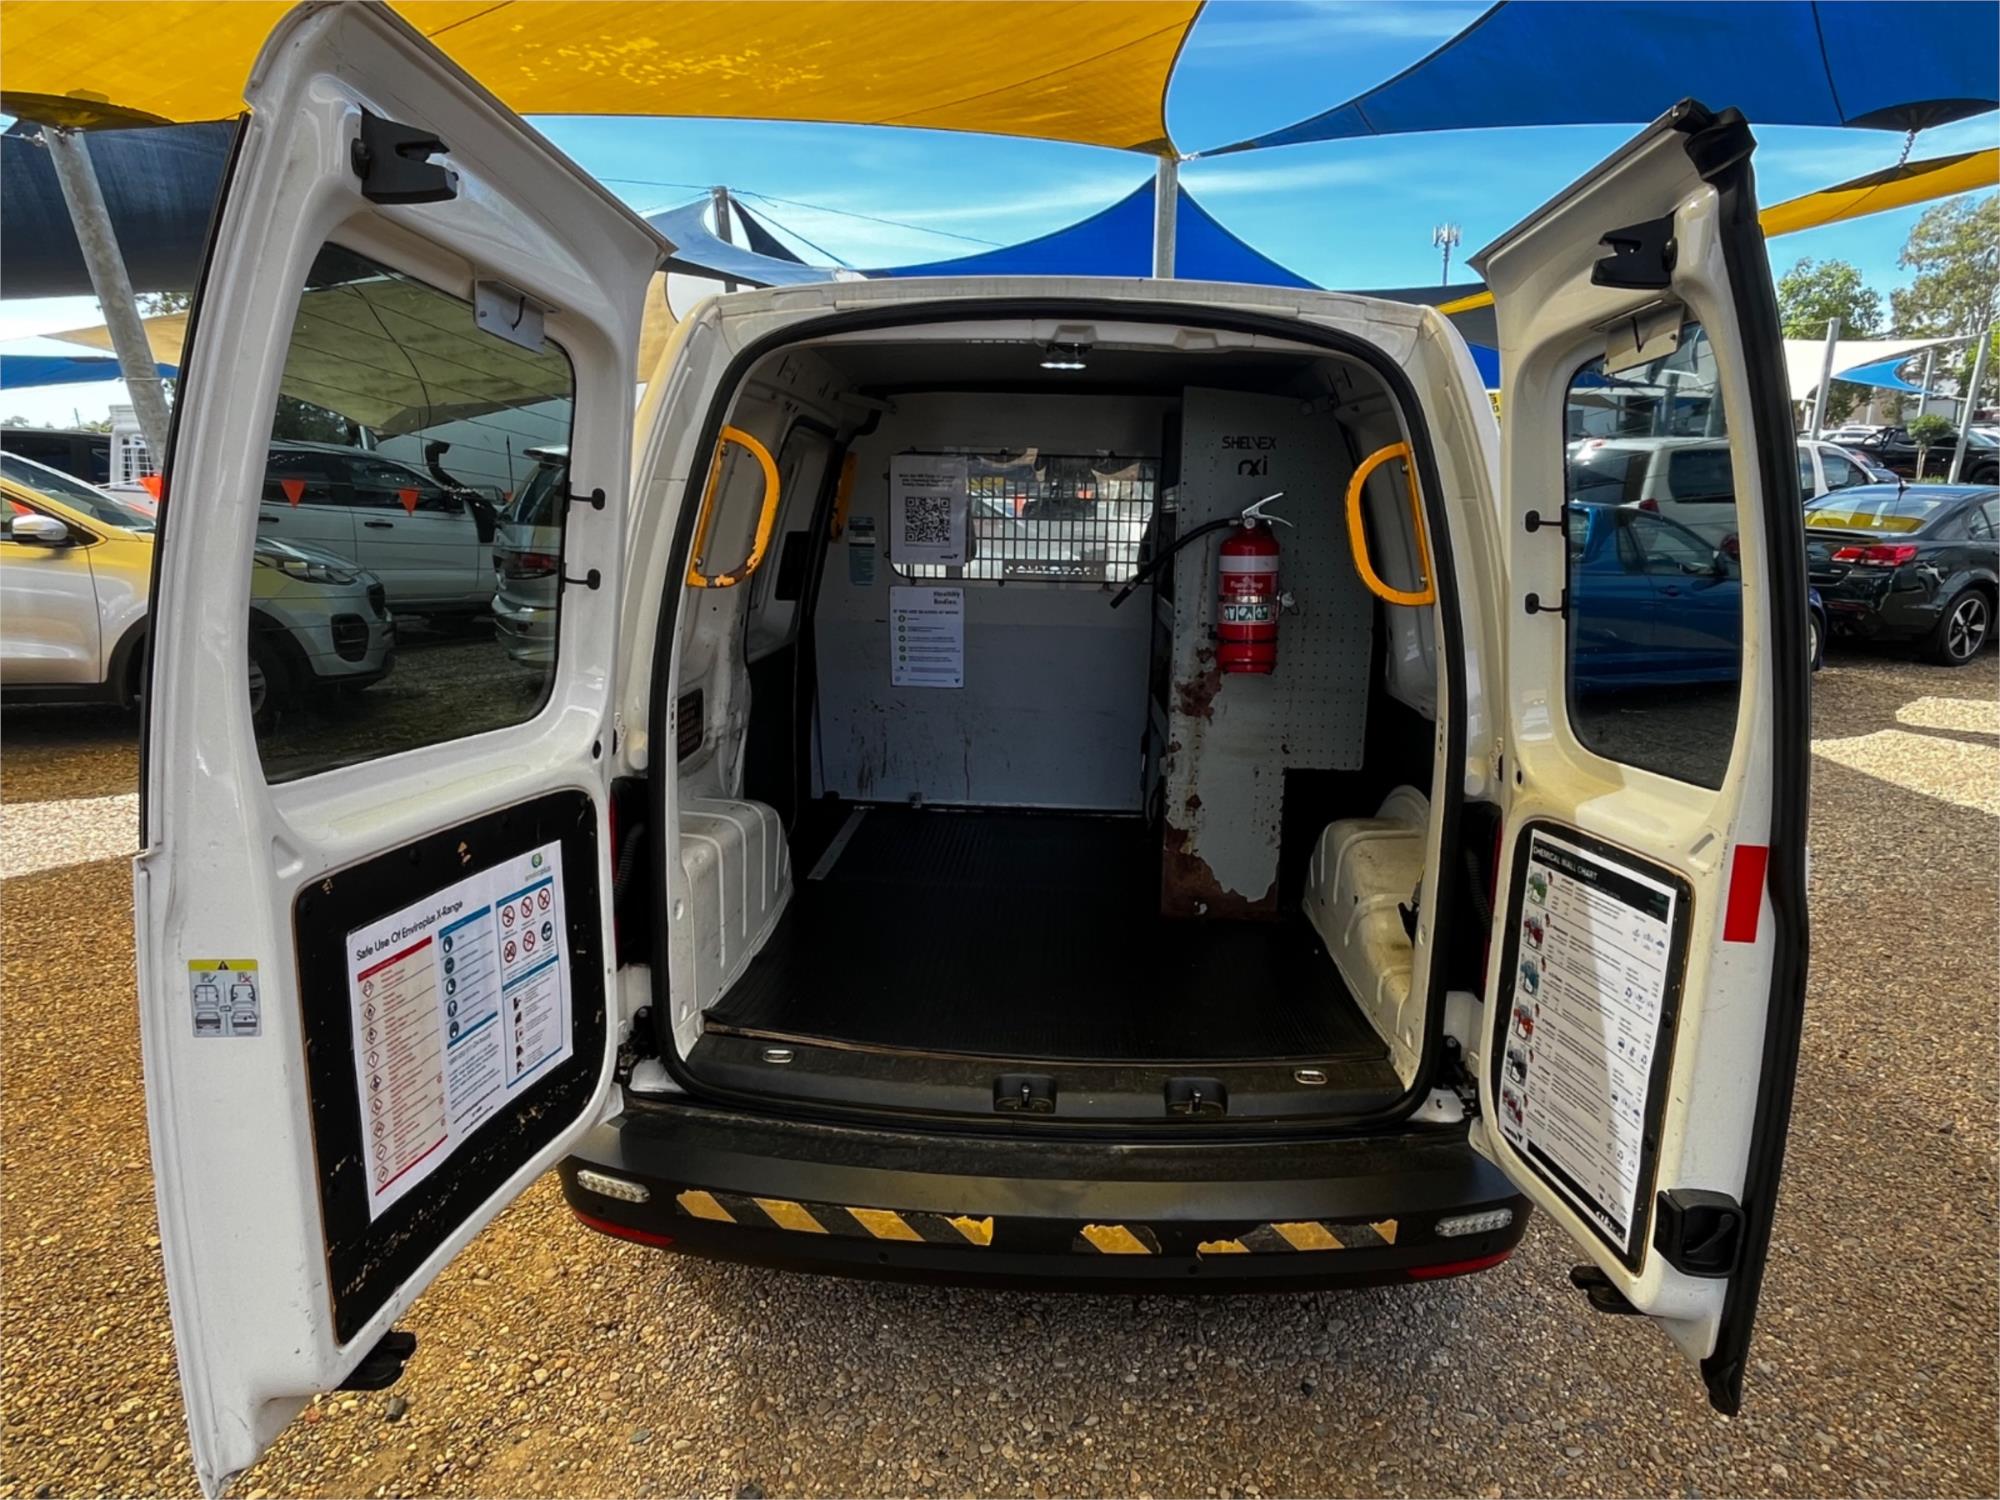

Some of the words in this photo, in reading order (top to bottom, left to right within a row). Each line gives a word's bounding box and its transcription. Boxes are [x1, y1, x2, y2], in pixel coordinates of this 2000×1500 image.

[1221, 435, 1277, 450] SHELVEX
[1577, 866, 1598, 881] CHART
[356, 945, 373, 961] Safe
[374, 938, 390, 952] Use
[391, 930, 401, 943] Of
[402, 913, 436, 939] Enviroplus
[436, 901, 463, 920] X-Range
